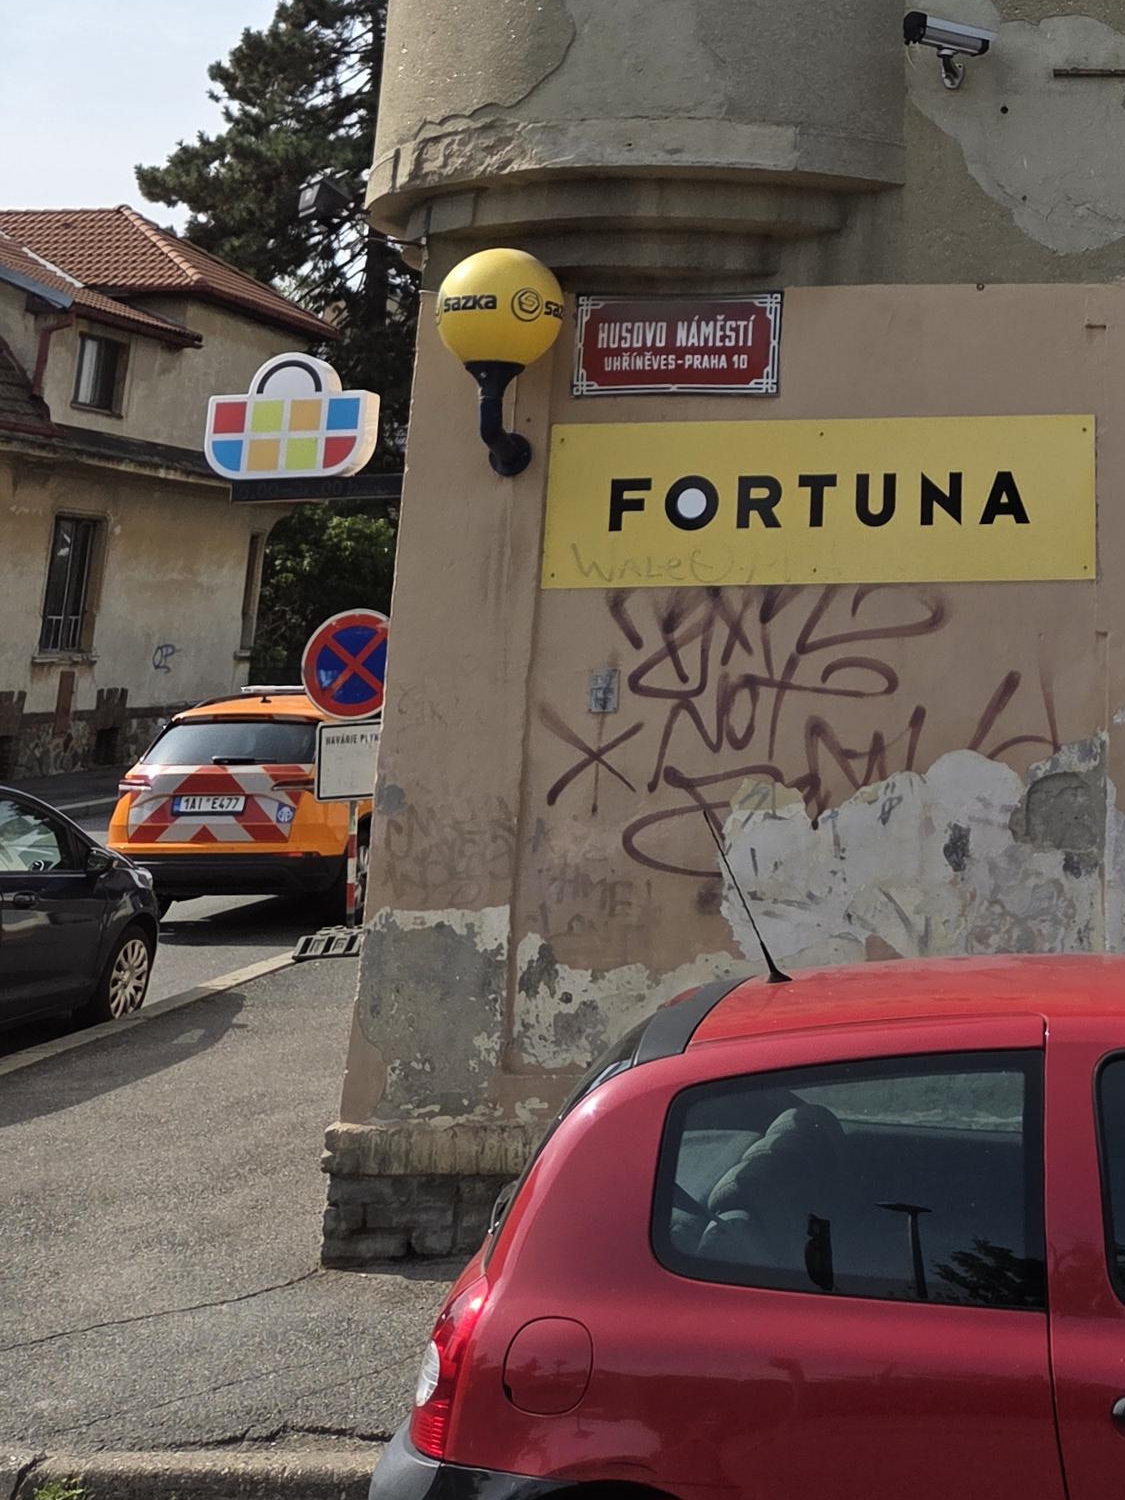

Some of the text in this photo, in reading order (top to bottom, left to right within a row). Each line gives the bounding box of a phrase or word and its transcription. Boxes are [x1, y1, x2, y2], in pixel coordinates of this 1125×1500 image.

[443, 294, 498, 314] sazka
[597, 314, 757, 349] HUSOVO NÁMĚSTÍ
[604, 351, 749, 372] UHŘÍNĚVES-PRAHA 10
[608, 470, 1031, 533] FORTUNA
[211, 797, 241, 810] E477
